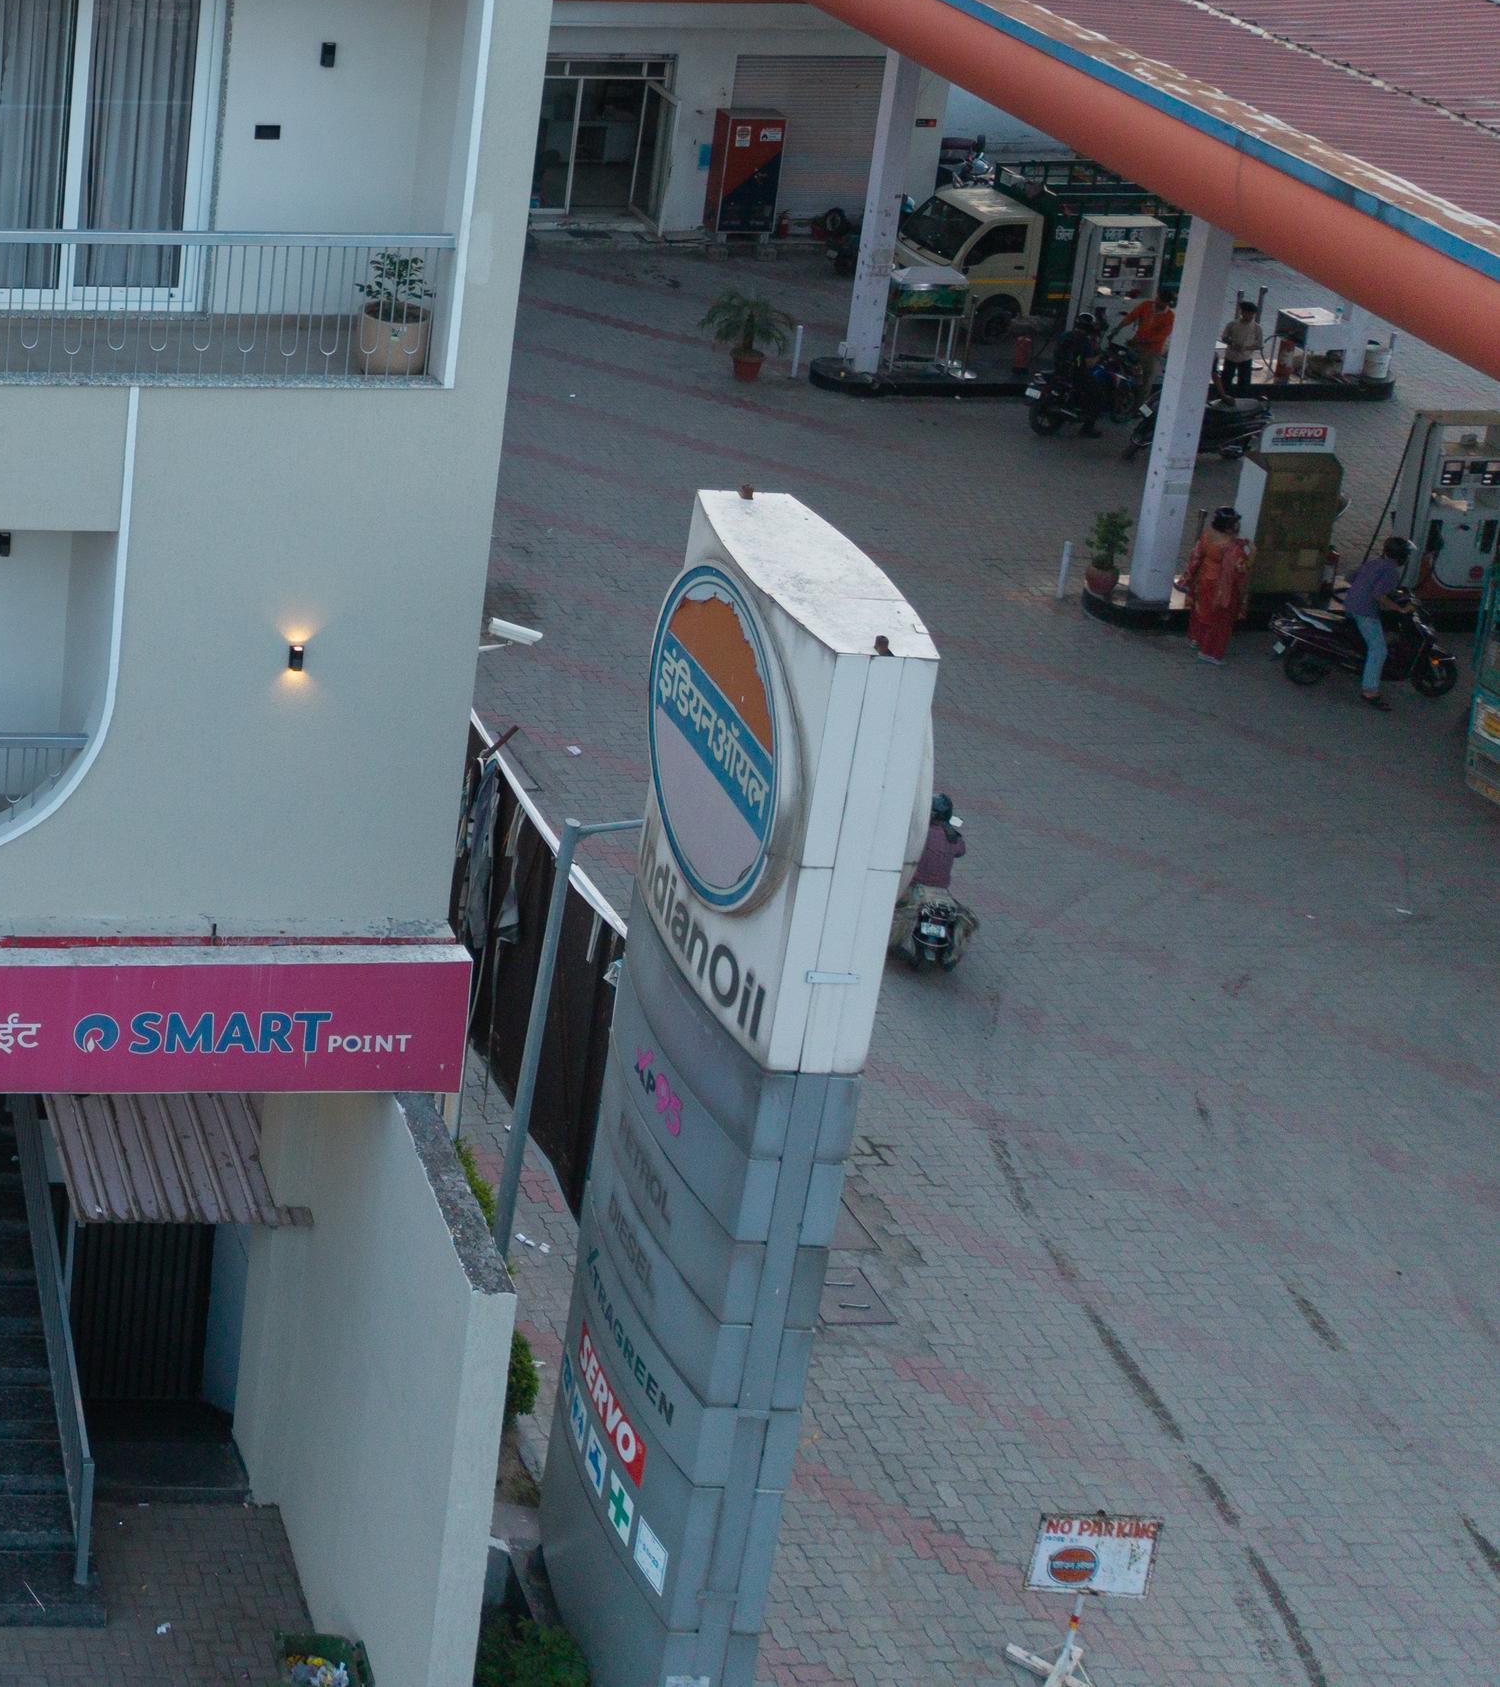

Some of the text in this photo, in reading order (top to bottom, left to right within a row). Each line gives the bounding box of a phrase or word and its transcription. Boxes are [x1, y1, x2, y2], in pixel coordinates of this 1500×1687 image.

[1286, 428, 1323, 438] SERVO
[640, 815, 766, 1042] IndianOil
[129, 1011, 412, 1054] SMART POINT
[619, 1112, 671, 1227] PETROL
[608, 1192, 655, 1300] DIESEL
[579, 1334, 637, 1463] SERVO
[1046, 1518, 1073, 1534] NO
[1079, 1519, 1157, 1539] PARKING
